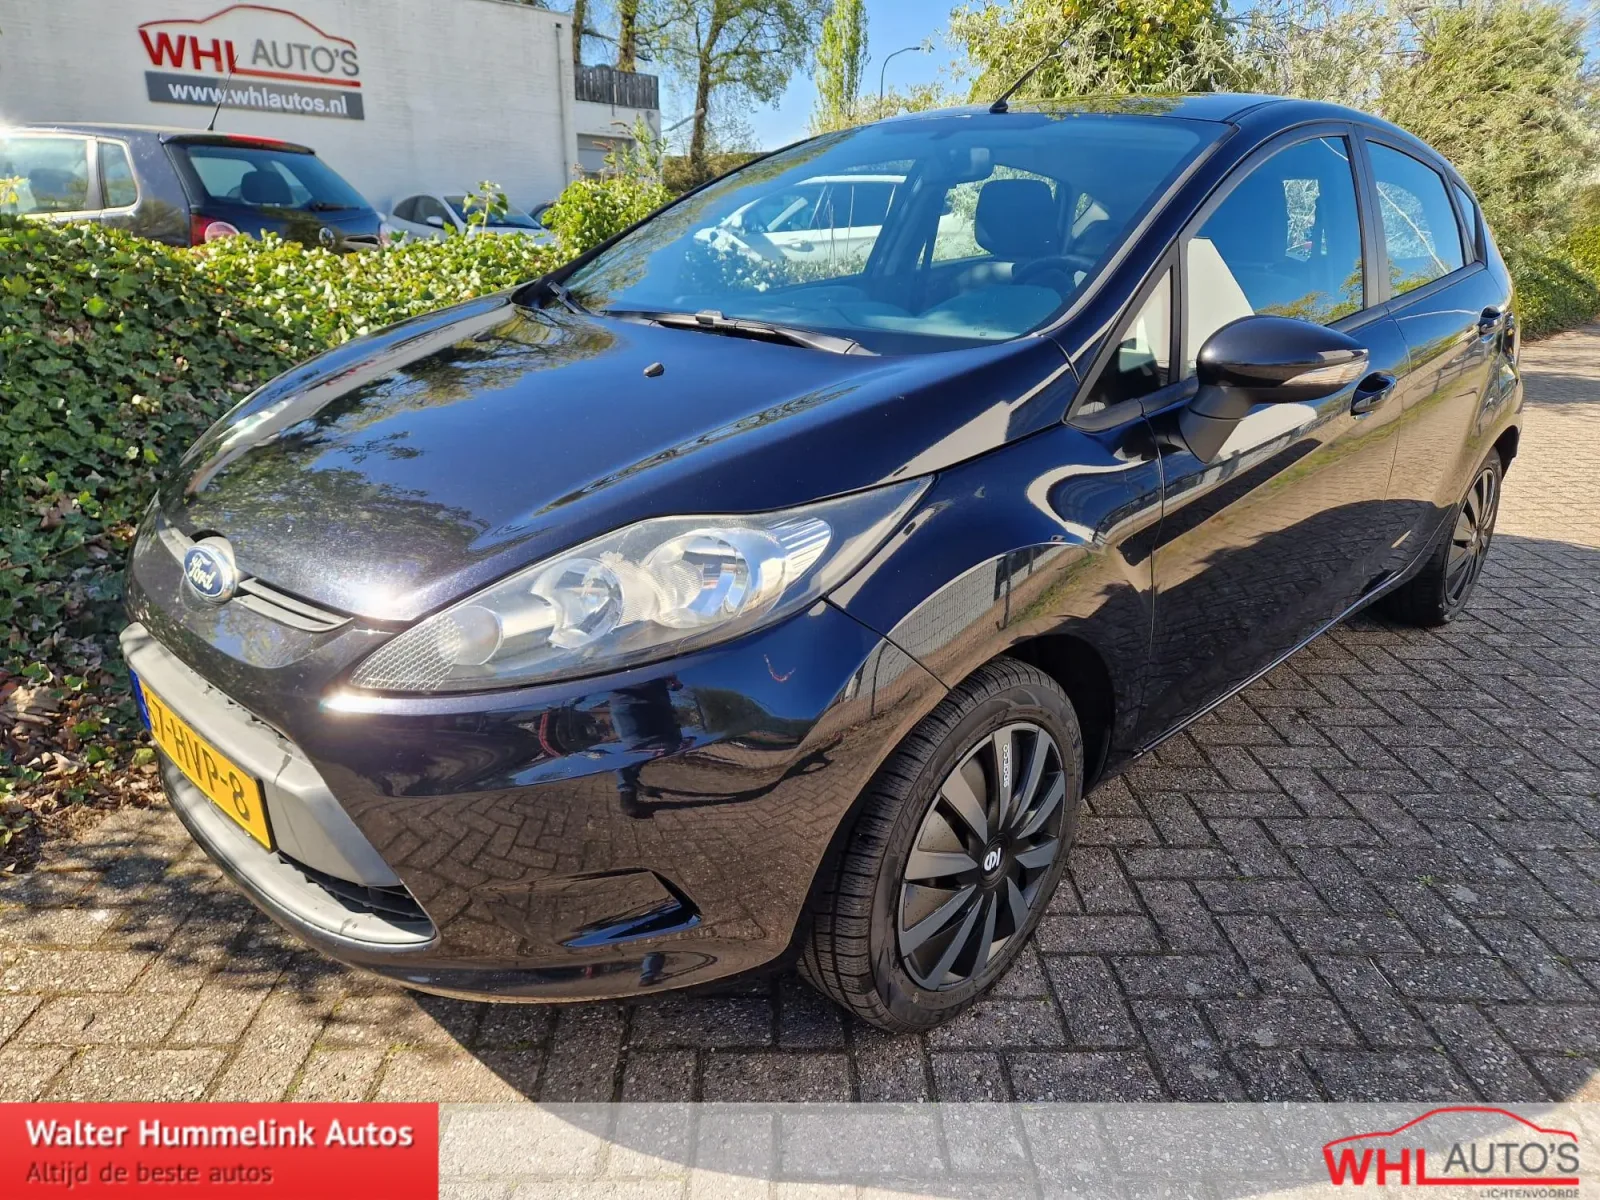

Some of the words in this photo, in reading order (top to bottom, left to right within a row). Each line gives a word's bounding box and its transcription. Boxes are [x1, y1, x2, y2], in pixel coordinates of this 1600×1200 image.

[138, 29, 237, 73] WHL
[251, 39, 360, 77] AUTO'S
[168, 84, 348, 114] www.whlautos.nl
[187, 552, 214, 591] Ford
